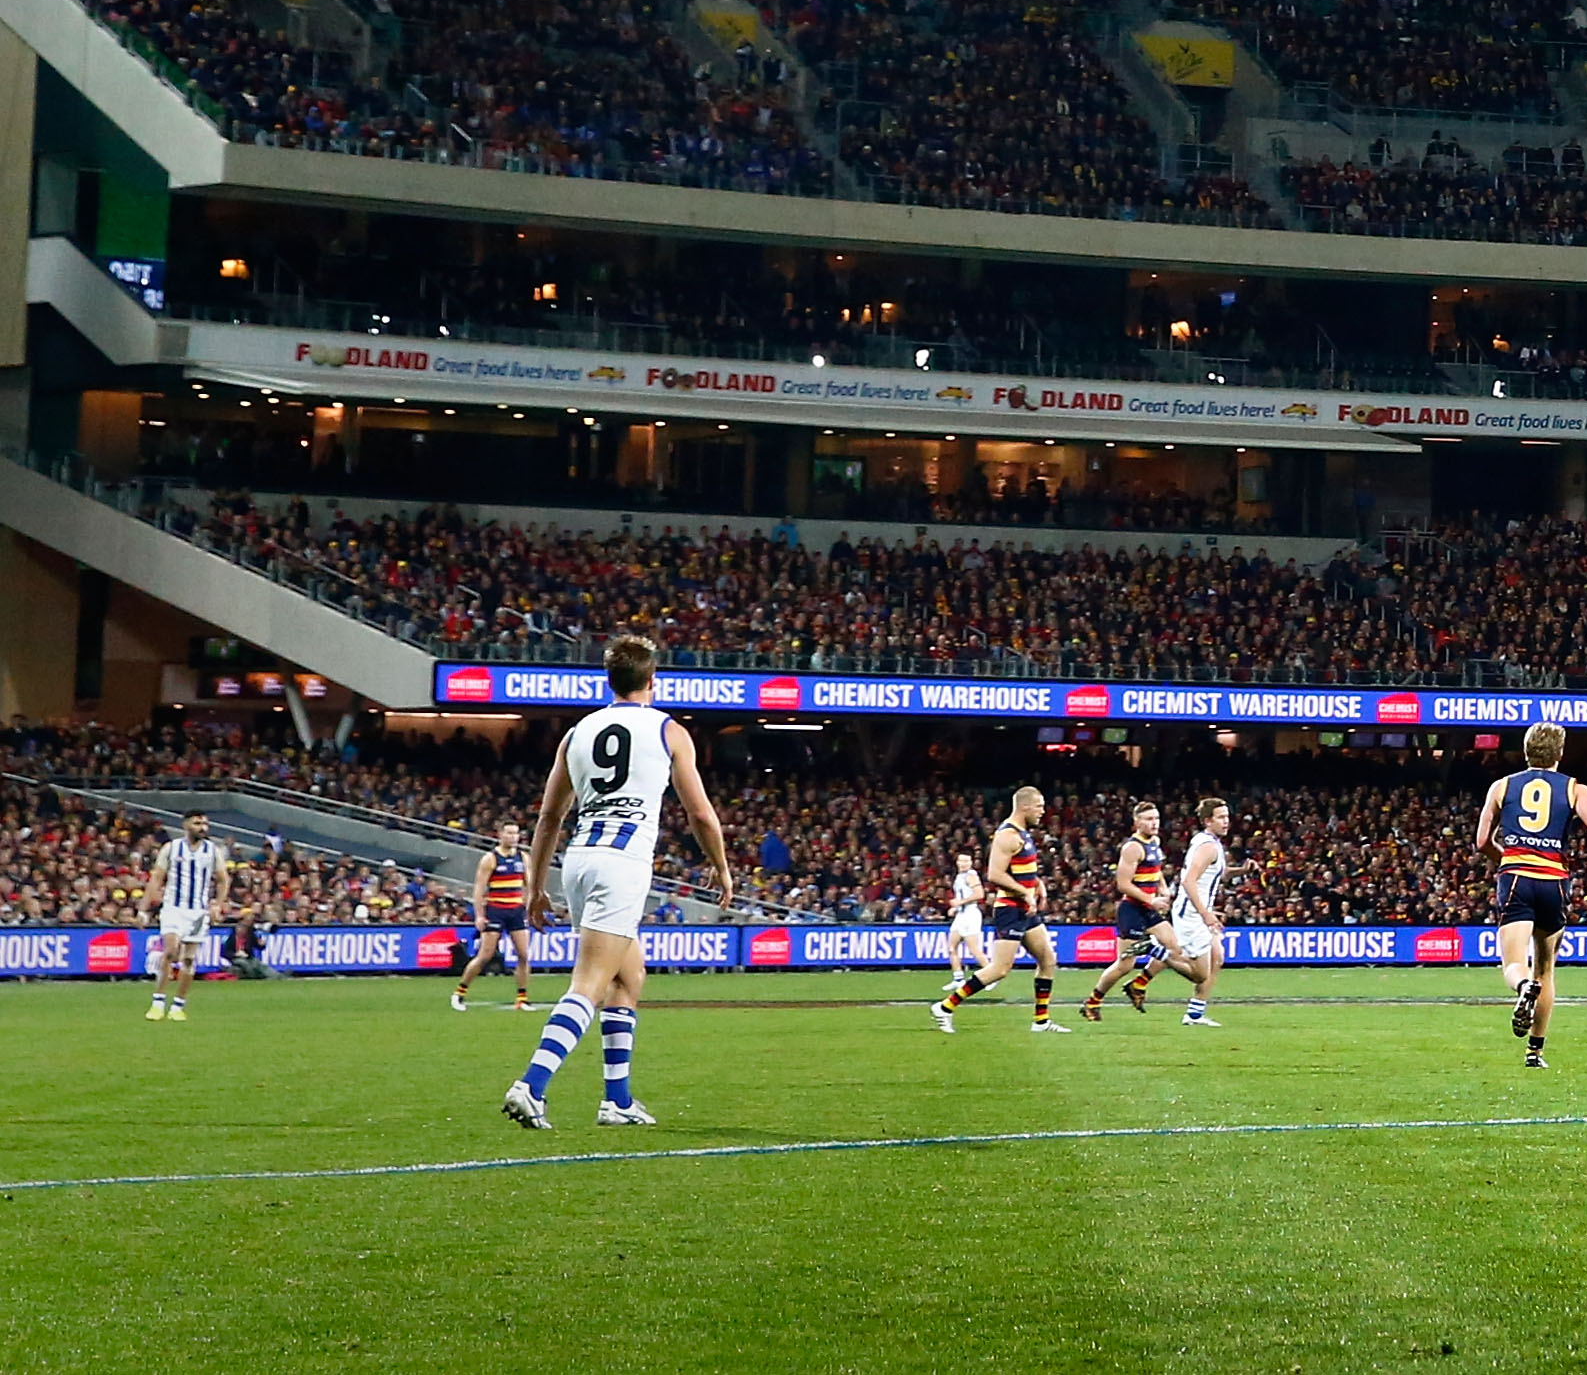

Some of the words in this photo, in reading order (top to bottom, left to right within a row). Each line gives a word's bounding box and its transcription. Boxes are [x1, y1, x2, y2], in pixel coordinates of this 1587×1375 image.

[781, 379, 821, 396] Great
[824, 380, 858, 400] food
[860, 383, 894, 399] lives
[896, 385, 930, 401] here!
[1128, 397, 1169, 413] Great
[1172, 399, 1206, 417] food
[1208, 401, 1239, 416] lives
[1240, 402, 1276, 419] here!
[1474, 412, 1514, 429] Great
[1517, 414, 1551, 433] food
[1553, 416, 1583, 430] lives
[506, 674, 607, 699] CHEMIST
[653, 678, 745, 703] REHOUSE
[814, 683, 914, 707] CHEMIST
[921, 686, 1050, 710] WAREHOUSE
[1123, 691, 1222, 714] CHEMIST
[1229, 694, 1361, 717] WAREHOUSE
[1434, 698, 1533, 721] CHEMIST
[591, 724, 631, 794] 9
[1518, 778, 1552, 833] 9
[1520, 836, 1561, 848] TOYOTA
[644, 931, 729, 962] EHOUSE
[805, 932, 907, 959] CHEMIST
[1250, 932, 1394, 957] WAREHOUSE
